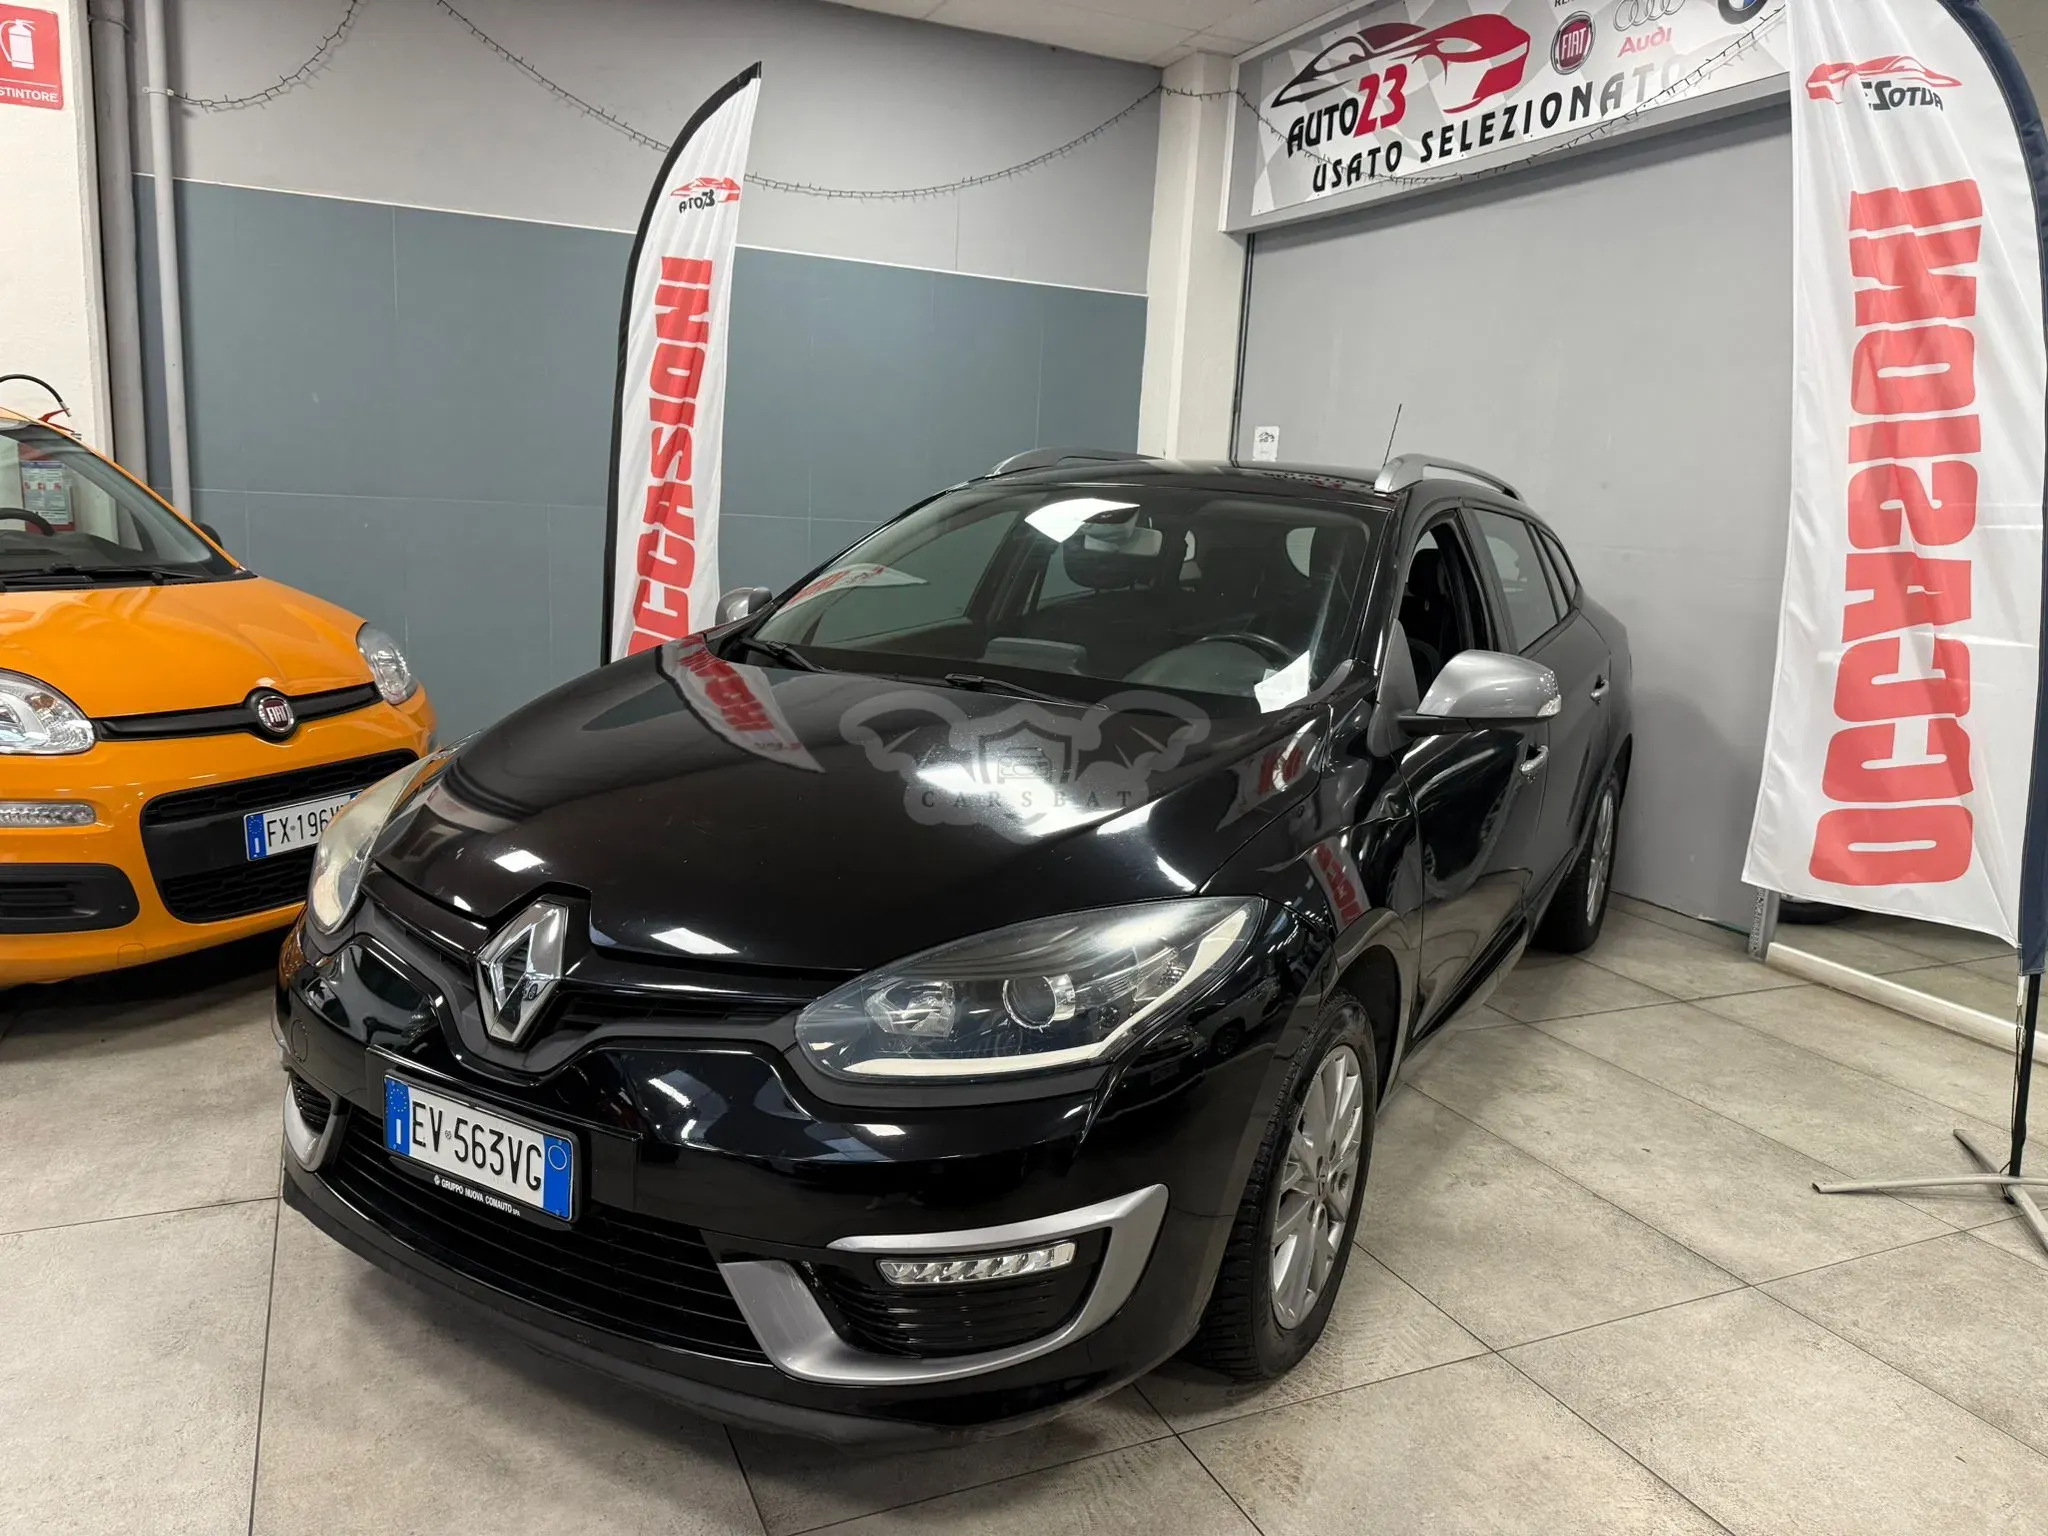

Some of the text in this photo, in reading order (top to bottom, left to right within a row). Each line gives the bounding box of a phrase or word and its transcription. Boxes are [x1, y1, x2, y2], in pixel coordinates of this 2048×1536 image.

[1561, 27, 1587, 60] FIAT
[1617, 26, 1672, 58] Audi
[0, 87, 58, 103] STINTORE
[1313, 54, 1688, 193] USATO SELEZIONATO
[266, 705, 288, 723] FIAT
[266, 816, 291, 847] FX
[297, 804, 344, 840] 196
[412, 1101, 443, 1153] EV
[453, 1117, 542, 1191] 563VG
[441, 1178, 464, 1195] GRUPPO
[465, 1187, 484, 1202] NUOVA
